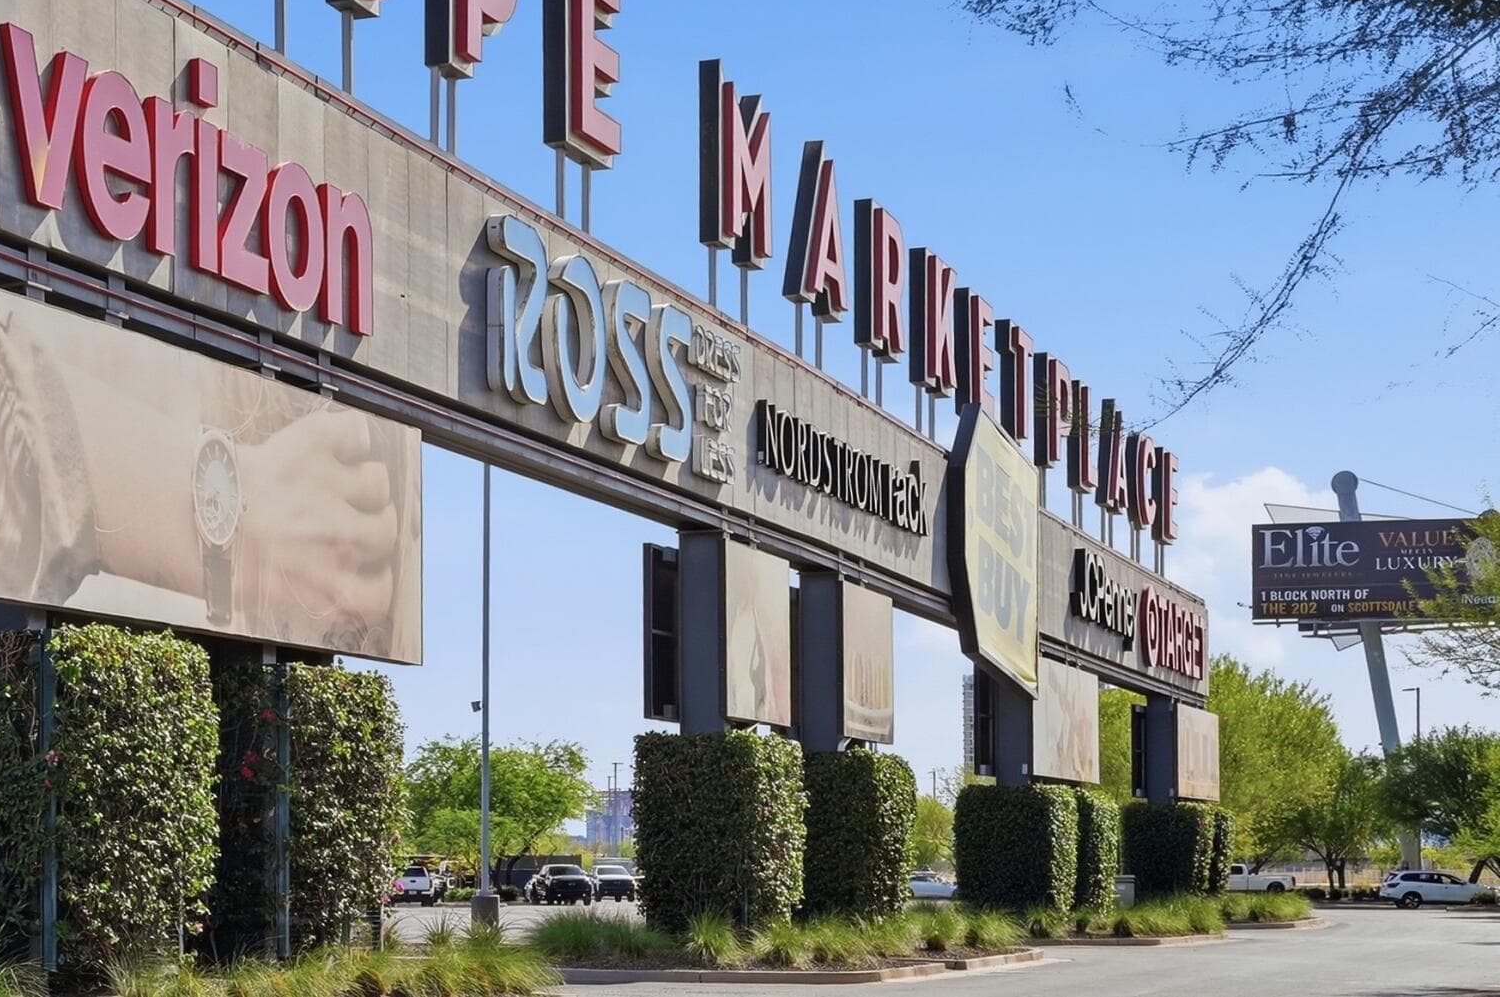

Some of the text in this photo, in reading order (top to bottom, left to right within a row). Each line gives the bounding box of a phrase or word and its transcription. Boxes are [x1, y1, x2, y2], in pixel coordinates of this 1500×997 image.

[699, 59, 1179, 545] MARKETPLACE
[486, 214, 692, 463] ROSS
[689, 325, 741, 383] DRESS
[696, 385, 732, 432] FOR
[693, 435, 735, 485] LESS
[757, 399, 930, 536] NORDSTROM rack
[977, 444, 1036, 567] BEST
[1259, 526, 1360, 568] Elite
[1376, 556, 1457, 570] LUXURY
[1378, 531, 1455, 547] VALUE
[978, 535, 1030, 644] BUY
[1071, 549, 1137, 651] JCPenney
[1261, 589, 1370, 601] 1 BLOCK NORTH OF
[1261, 601, 1415, 614] THE 202 ON SCOTTSDALE
[1155, 594, 1205, 681] TARGET
